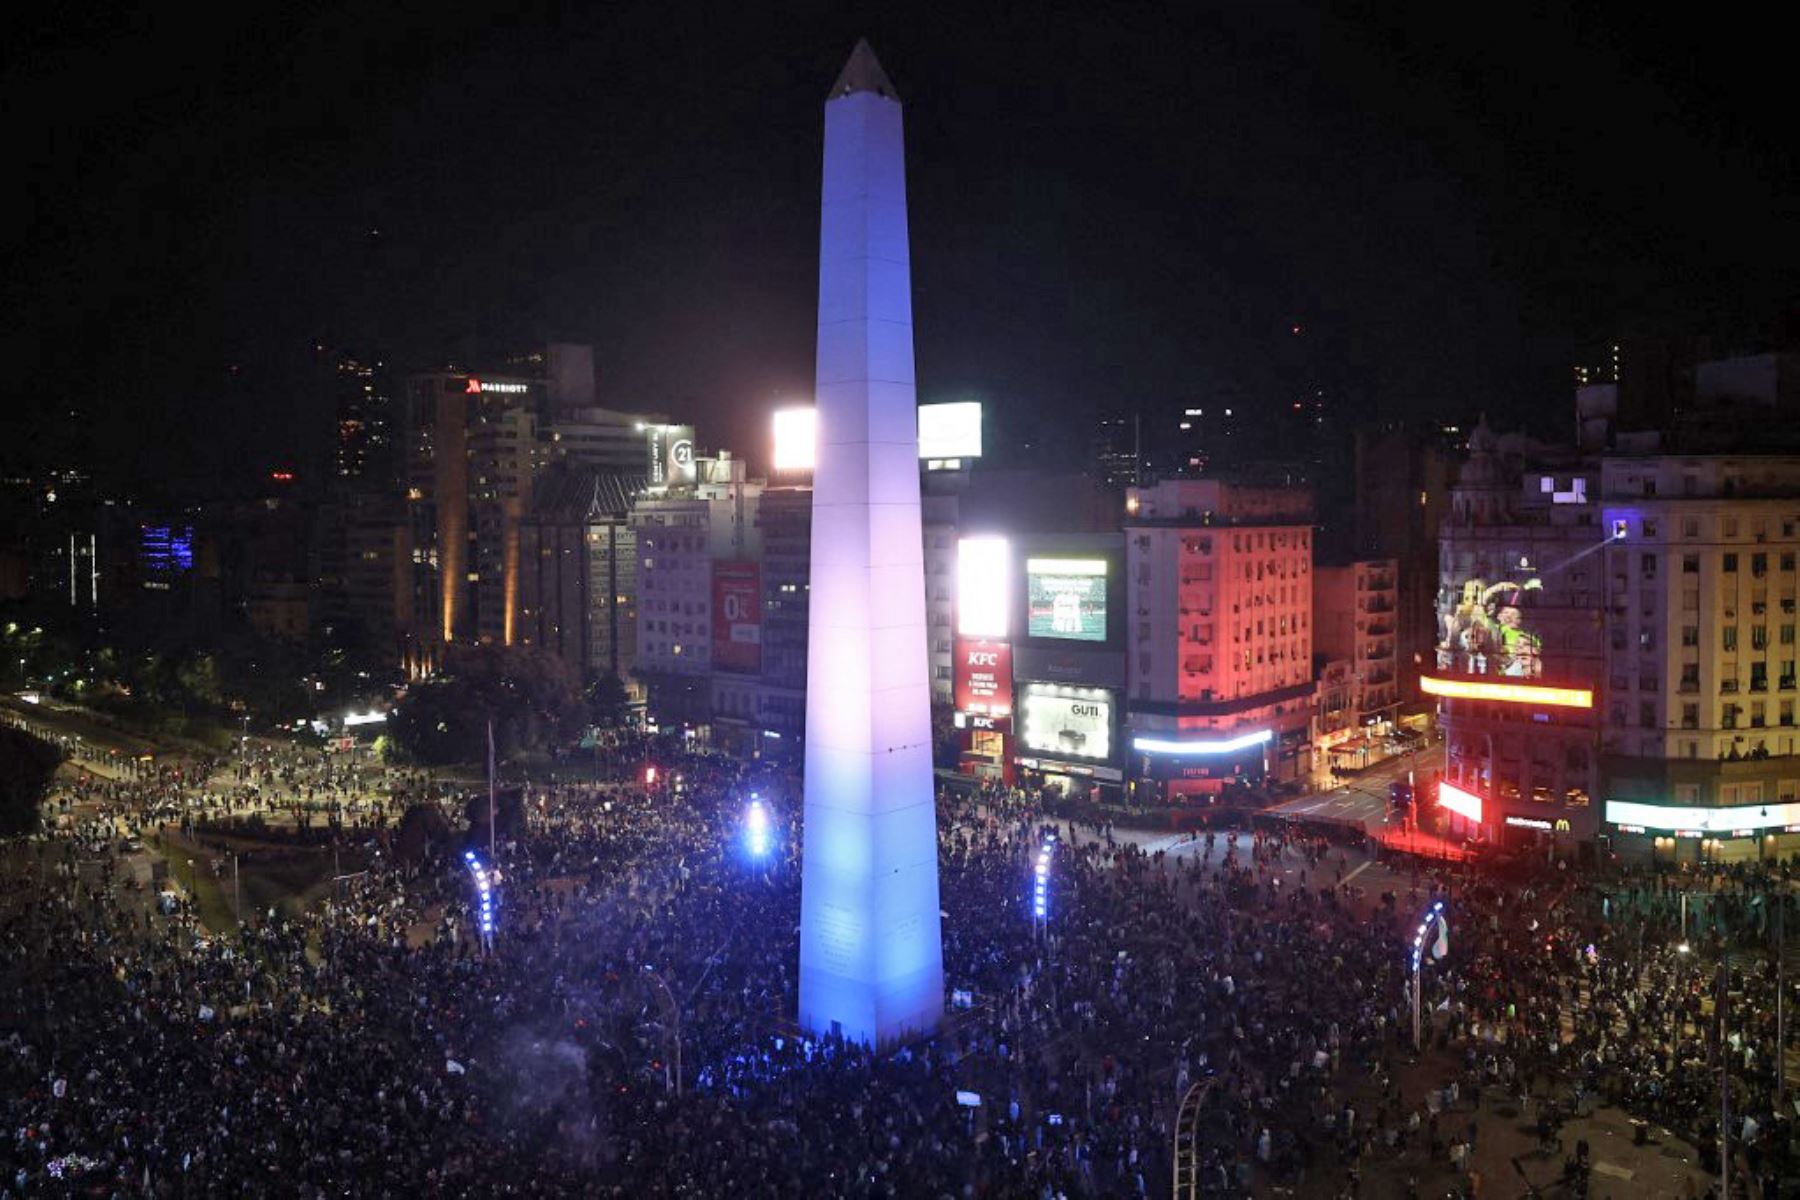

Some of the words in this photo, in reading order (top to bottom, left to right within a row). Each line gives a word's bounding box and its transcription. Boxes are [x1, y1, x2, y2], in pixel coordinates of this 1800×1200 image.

[481, 383, 528, 393] MARRIOTT
[968, 651, 998, 666] KFC
[973, 717, 995, 728] KFC
